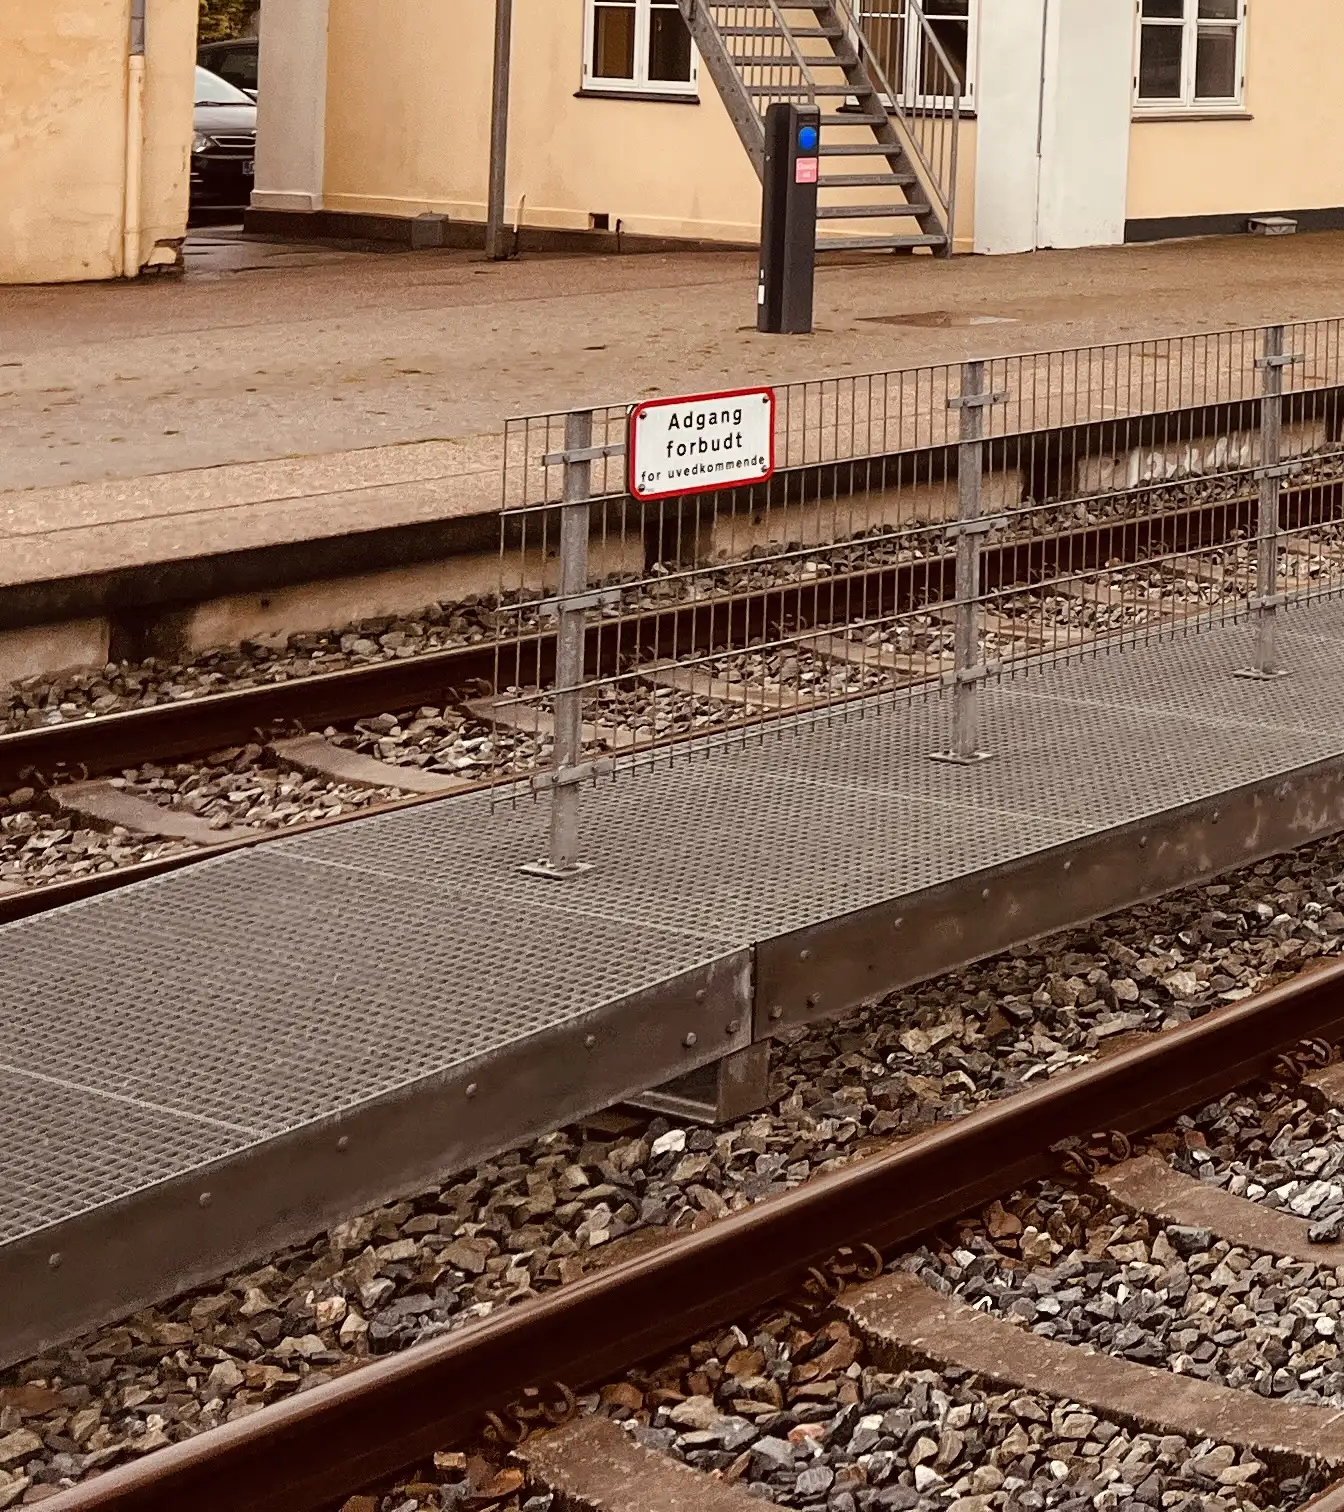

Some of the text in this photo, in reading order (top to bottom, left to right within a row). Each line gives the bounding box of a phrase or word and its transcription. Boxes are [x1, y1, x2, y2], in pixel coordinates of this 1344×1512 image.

[668, 408, 743, 431] Adgang
[666, 431, 743, 458] forbudt
[641, 455, 765, 482] for uvedkommende
